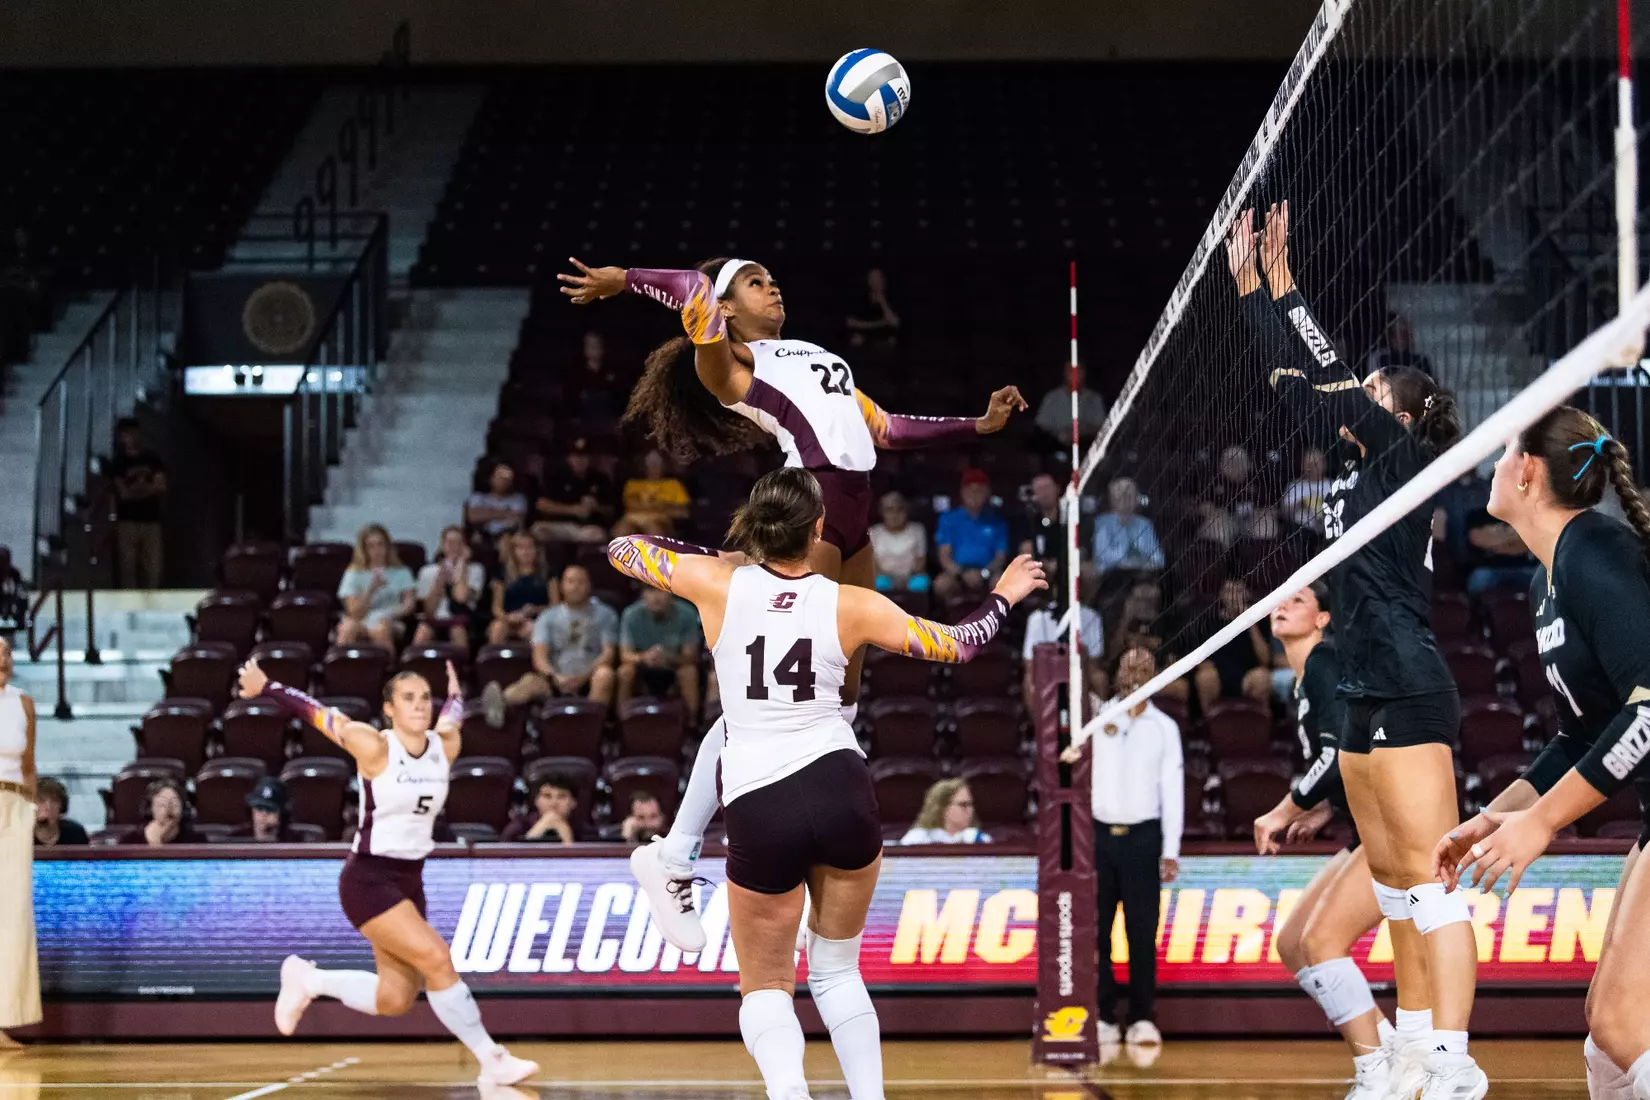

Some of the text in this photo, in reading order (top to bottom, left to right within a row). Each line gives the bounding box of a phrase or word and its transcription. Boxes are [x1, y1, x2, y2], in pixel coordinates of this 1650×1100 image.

[811, 363, 852, 396] 22
[746, 635, 817, 702] 14
[412, 795, 433, 815] 5
[449, 882, 812, 973] WELCOM
[1056, 891, 1073, 997] sports imports
